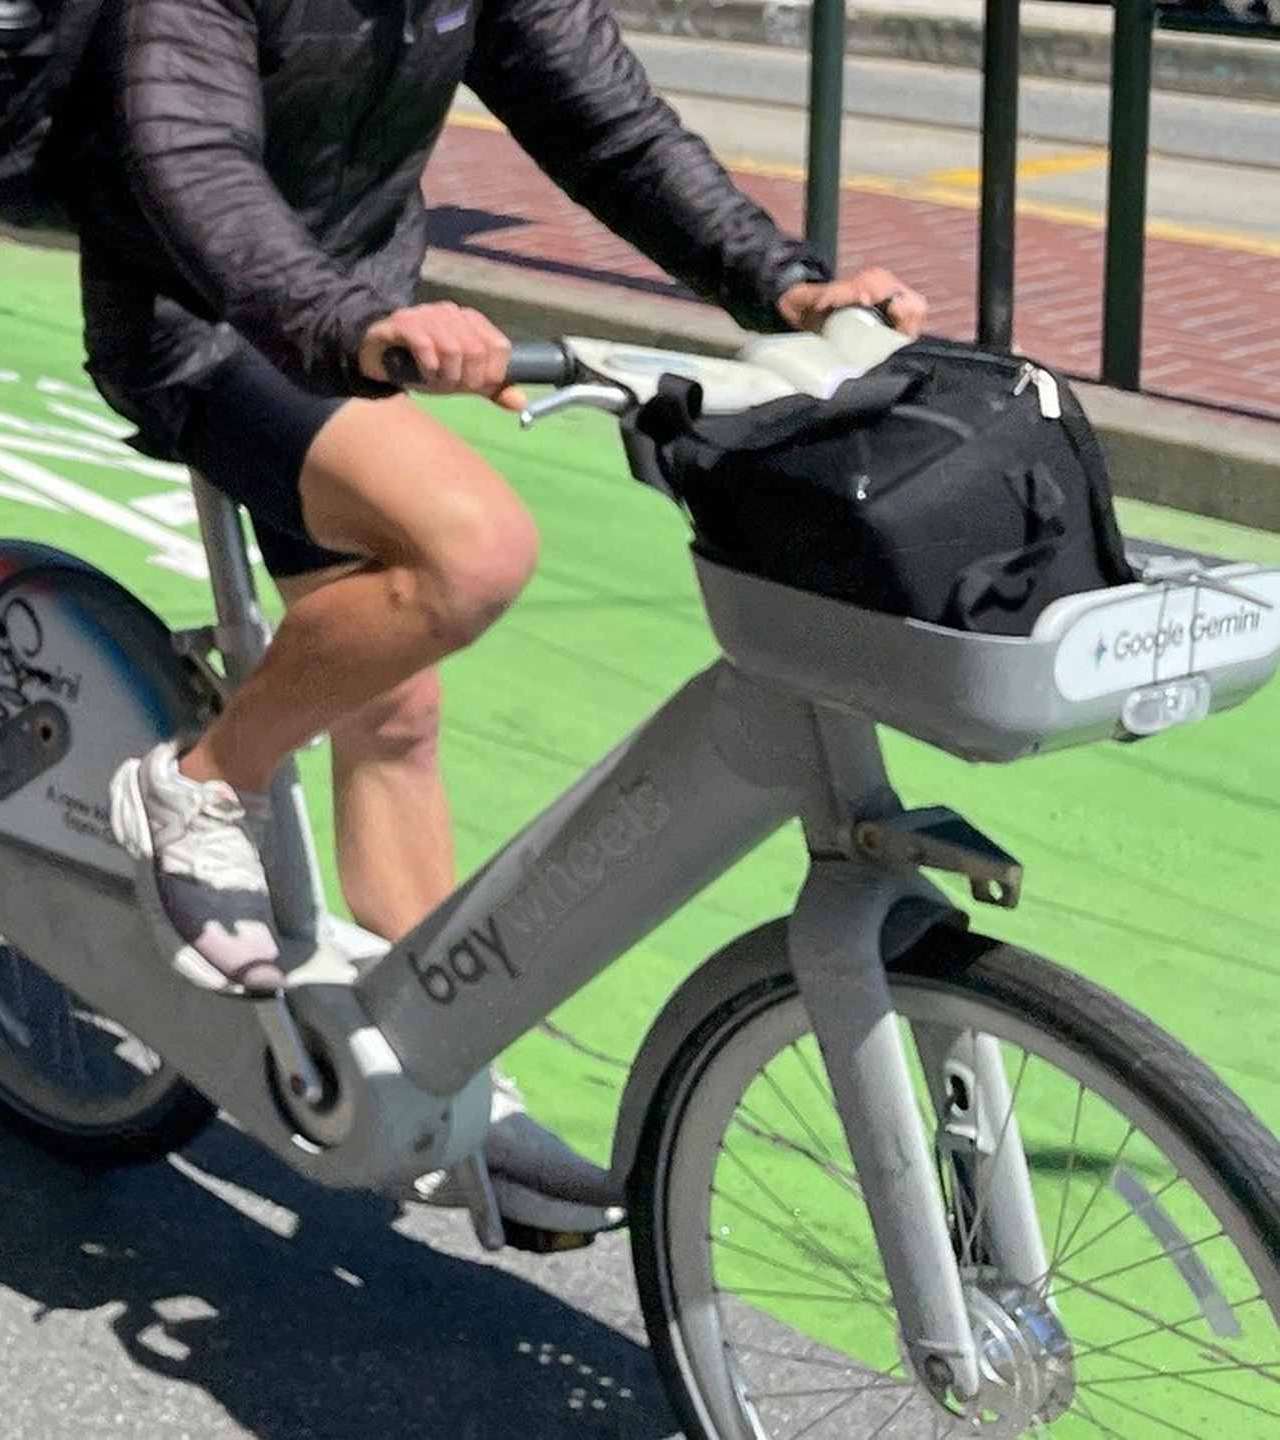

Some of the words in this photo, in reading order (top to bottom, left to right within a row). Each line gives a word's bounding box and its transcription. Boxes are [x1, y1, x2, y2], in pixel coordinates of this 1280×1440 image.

[1113, 618, 1185, 658] Google
[1191, 603, 1261, 642] Gemini
[408, 917, 522, 1005] bay
